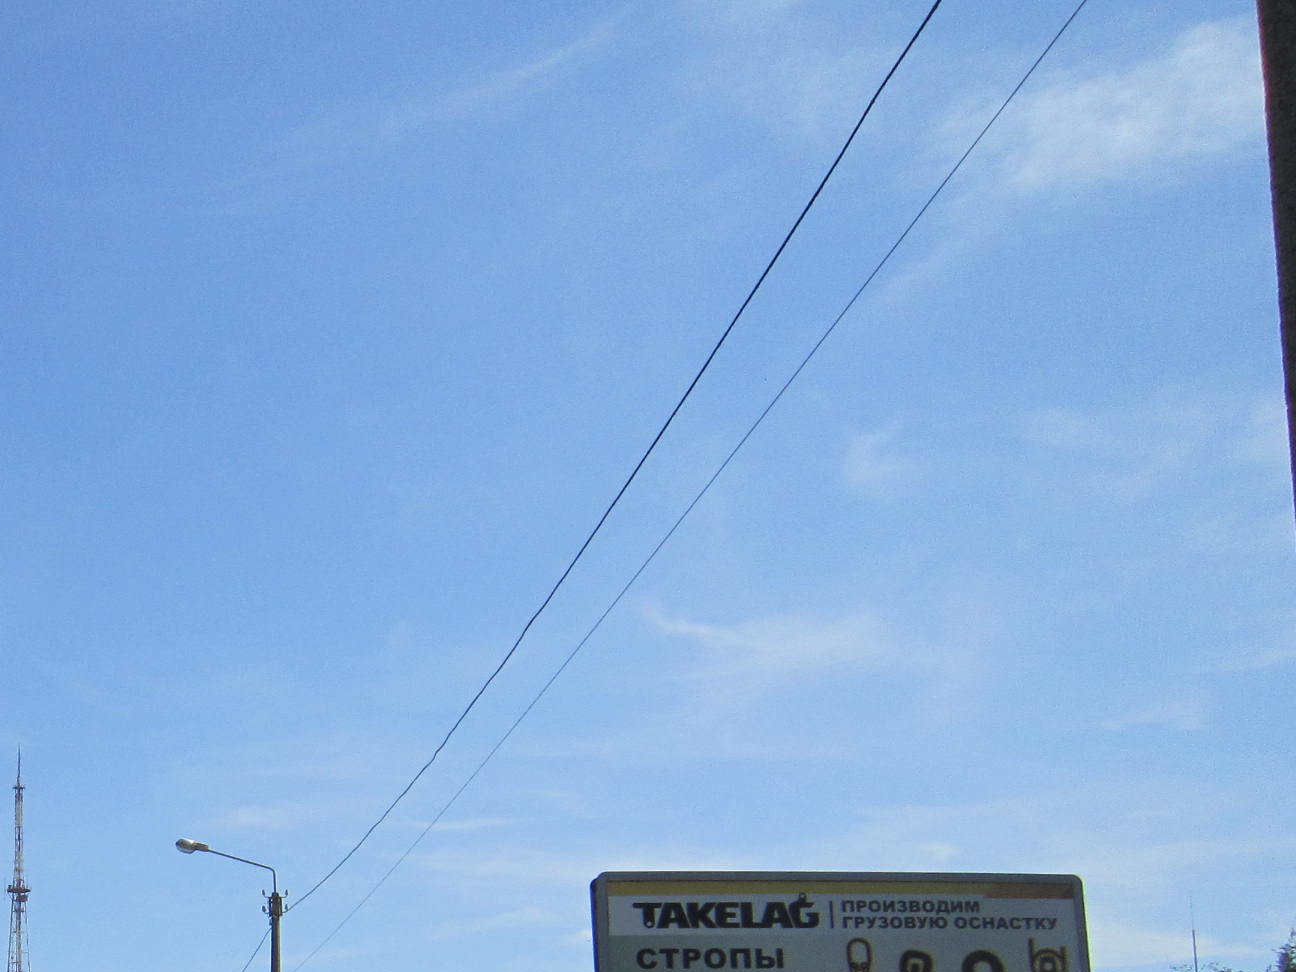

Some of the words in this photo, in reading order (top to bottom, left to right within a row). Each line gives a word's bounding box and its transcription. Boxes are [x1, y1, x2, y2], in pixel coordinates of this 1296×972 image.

[632, 893, 820, 929] TAKELAG
[842, 900, 980, 915] ПРОИЗВОДИМ
[842, 916, 948, 930] ГРУЗОВУЮ
[953, 917, 1057, 930] ОСНАСТКУ
[636, 948, 785, 970] СТРОПЫ
